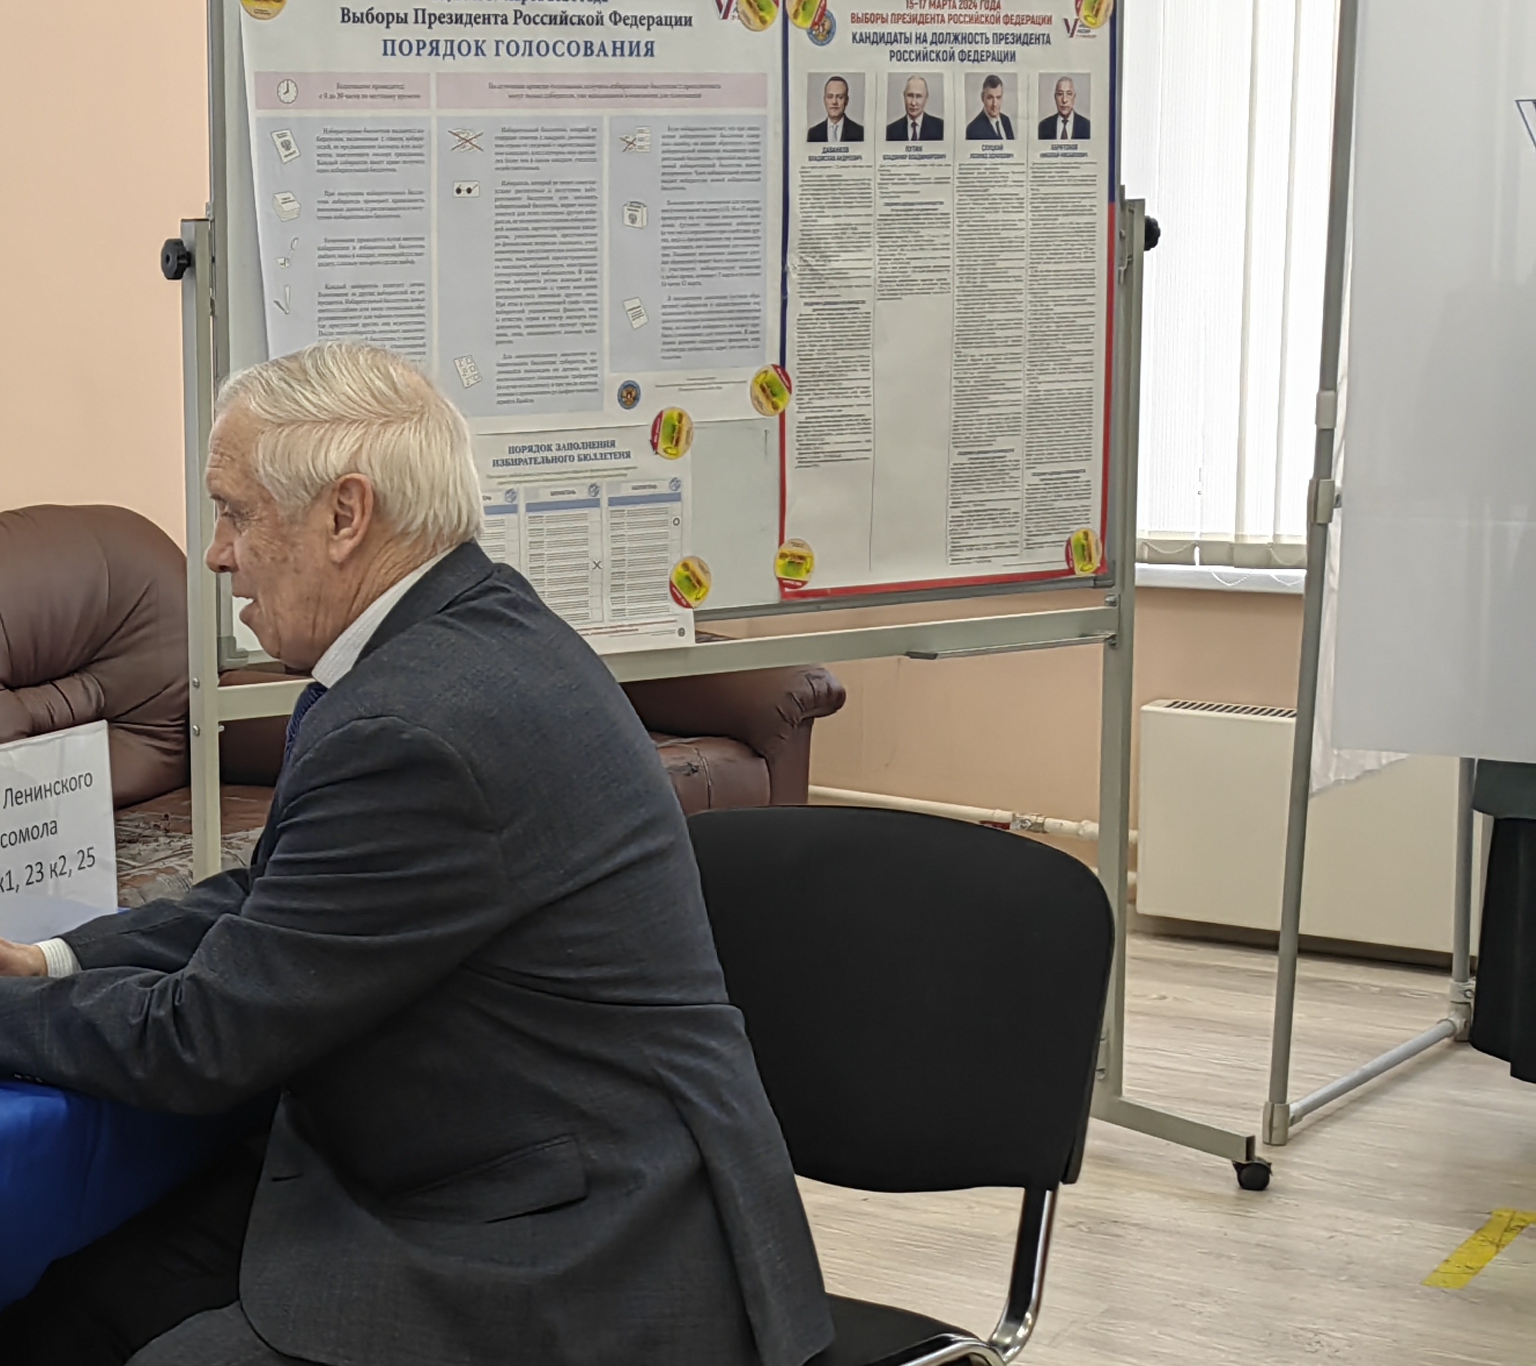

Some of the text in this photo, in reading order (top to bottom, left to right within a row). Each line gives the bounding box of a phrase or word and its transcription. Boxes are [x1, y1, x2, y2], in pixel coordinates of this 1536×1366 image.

[958, 0, 977, 10] 2024
[979, 0, 1001, 11] ГОДА
[340, 7, 693, 30] Выборы Президента Российской Федерации
[850, 11, 1053, 26] ВЫБОРЫ ПРЕЗИДЕНТА РОССИЙСКОЙ ФЕДЕРАЦИИ
[851, 31, 1051, 46] КАНДИДАТЫ НА ДОЛЖНОСТЬ ПРЕЗИДЕНТА
[382, 39, 656, 60] ПОРЯДОК ГОЛОСОВАНИЯ
[889, 47, 1016, 63] РОССИЙСКОЙ ФЕДЕРАЦИИ
[508, 440, 616, 454] ПОРЯДОК ЗАПОЛНЕНИЯ
[492, 450, 631, 467] ИЗБИРАТЕЛЬНОГО БЮЛЛЕТЕНЯ
[2, 772, 93, 810] Ленинского
[24, 861, 44, 886] 23
[49, 855, 72, 879] к2,
[76, 847, 96, 873] 25
